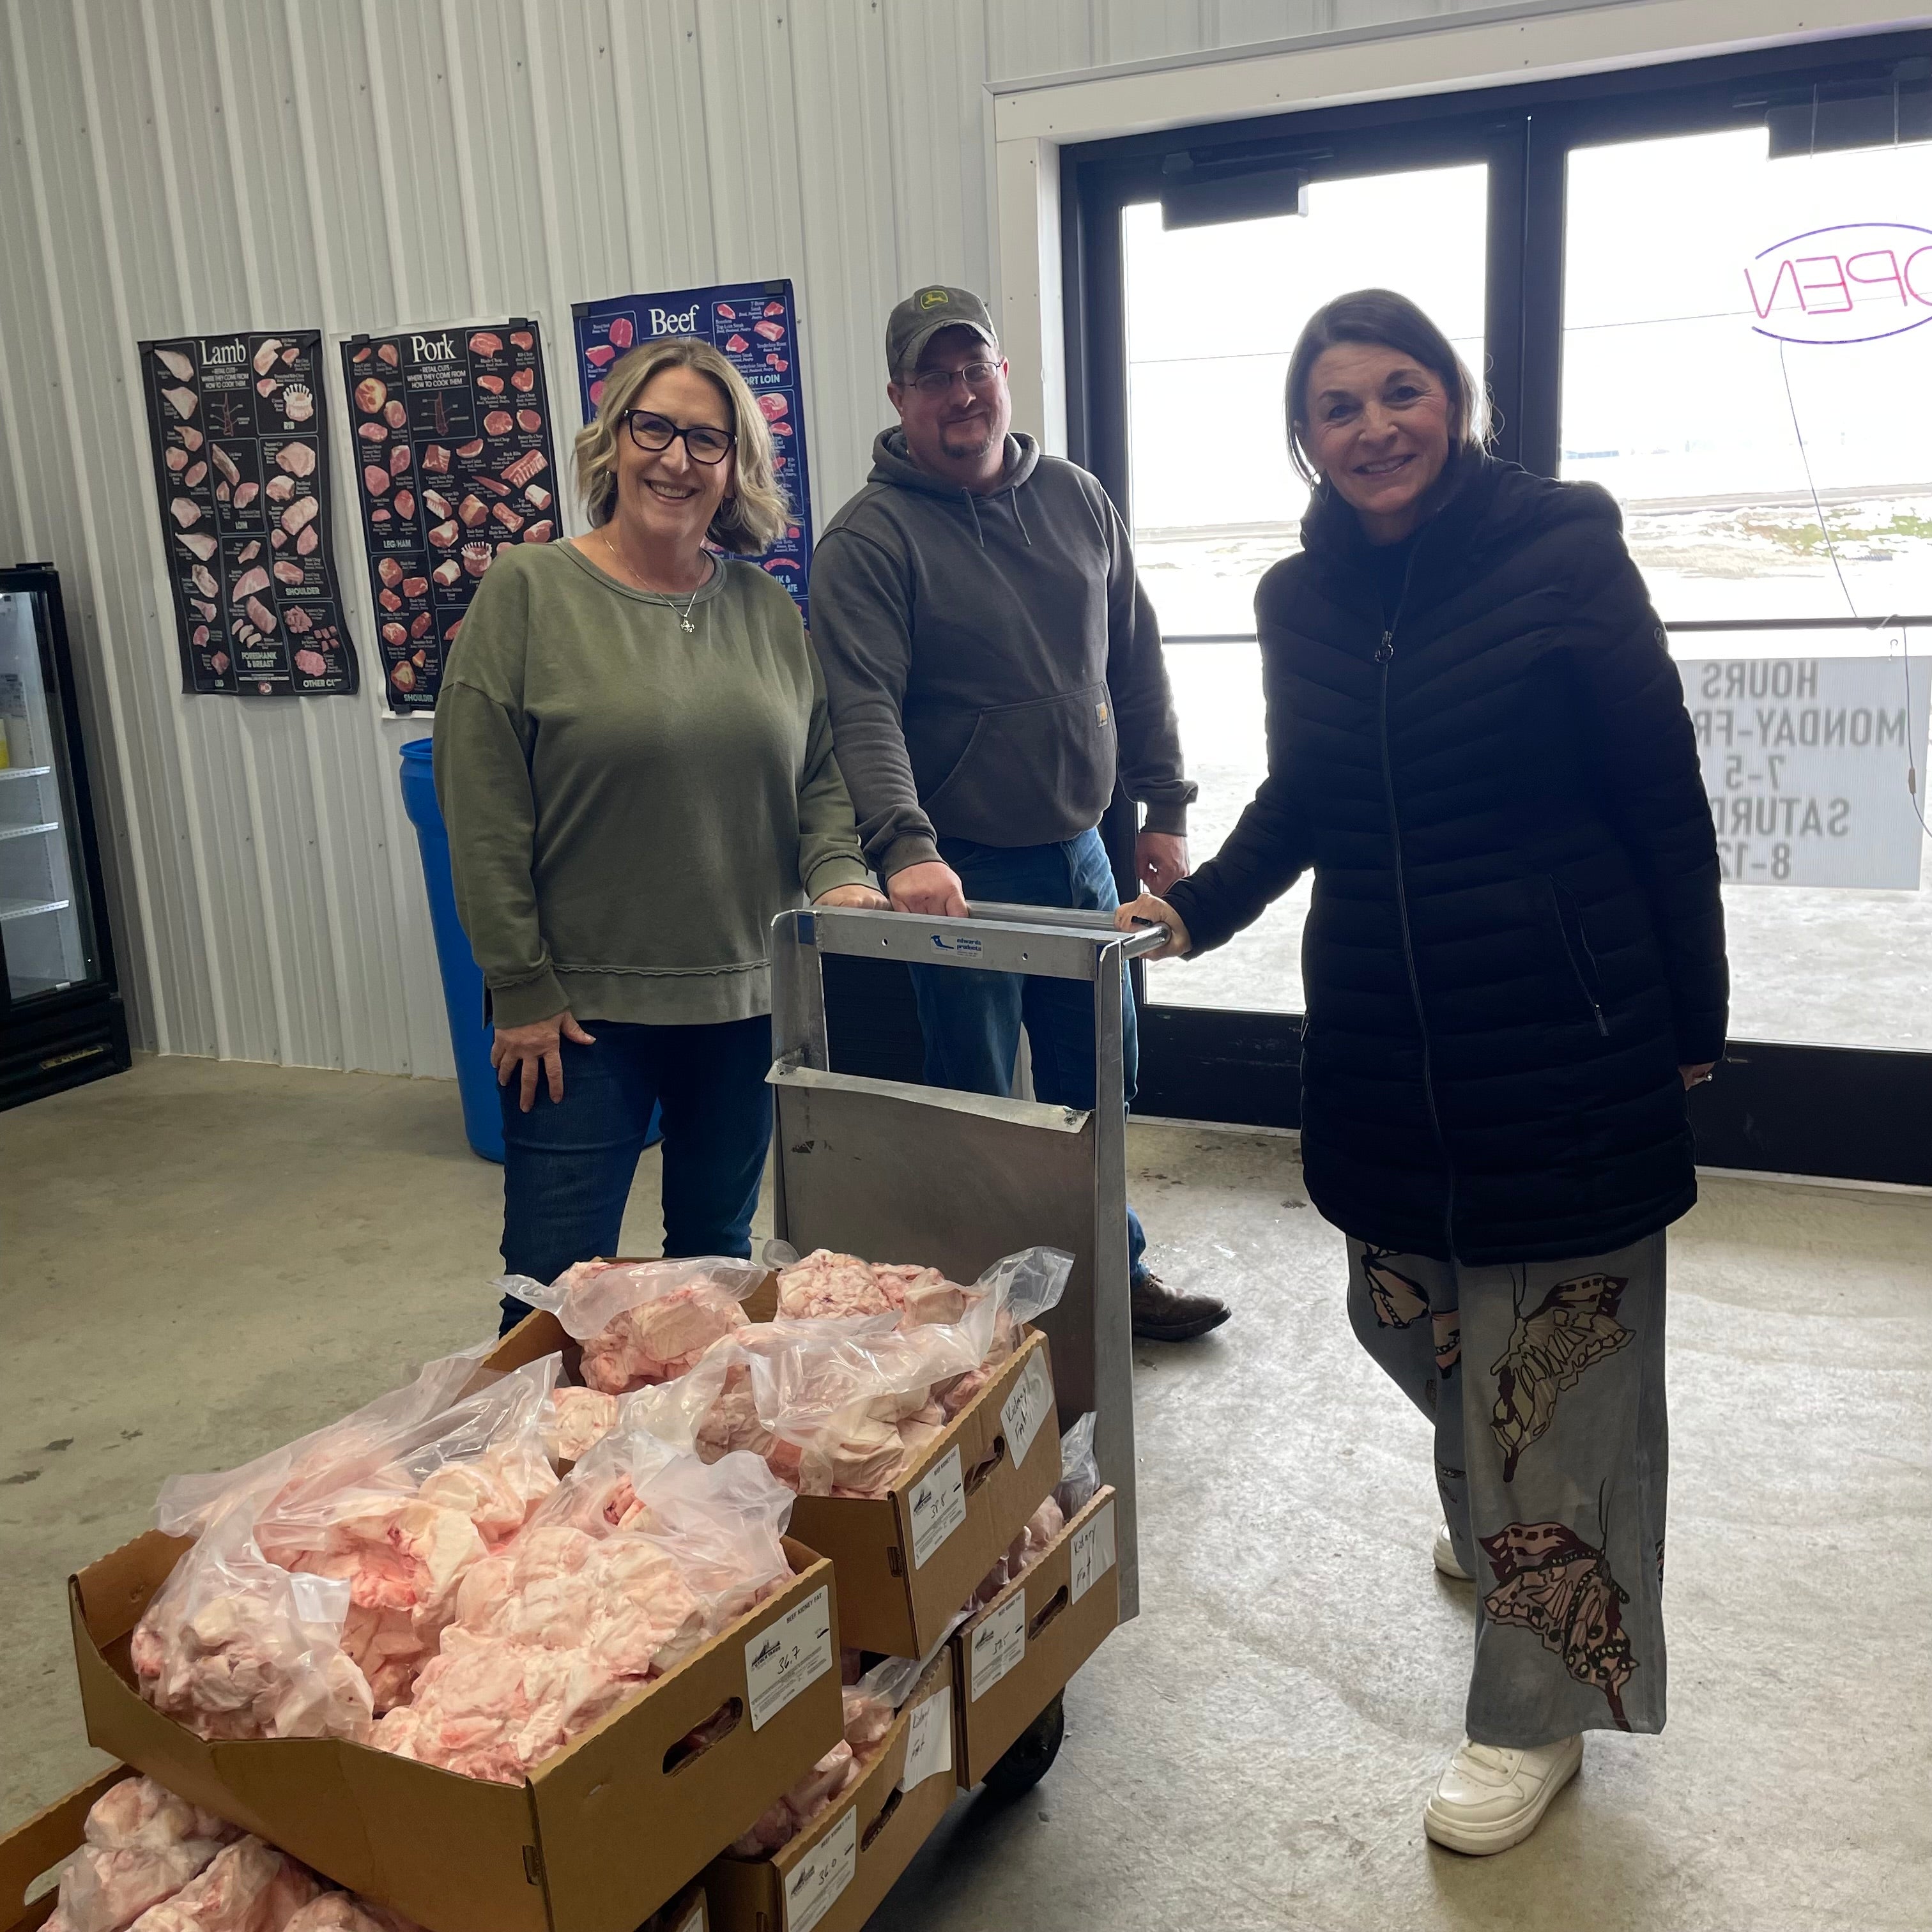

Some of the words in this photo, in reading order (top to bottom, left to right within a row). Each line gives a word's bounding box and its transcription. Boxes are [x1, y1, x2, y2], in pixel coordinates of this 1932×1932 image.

[648, 305, 700, 335] Beef
[199, 338, 246, 365] Lamb
[410, 334, 457, 363] Pork
[744, 376, 759, 385] ORT
[760, 374, 780, 385] LOIN
[785, 575, 791, 583] &
[786, 584, 799, 593] ATE
[303, 679, 325, 688] OTHER
[1005, 1387, 1027, 1423] Kidney
[786, 1611, 797, 1624] BEEF
[797, 1599, 813, 1615] KIDNEY
[814, 1592, 822, 1603] FAT
[777, 1645, 800, 1675] 36.7
